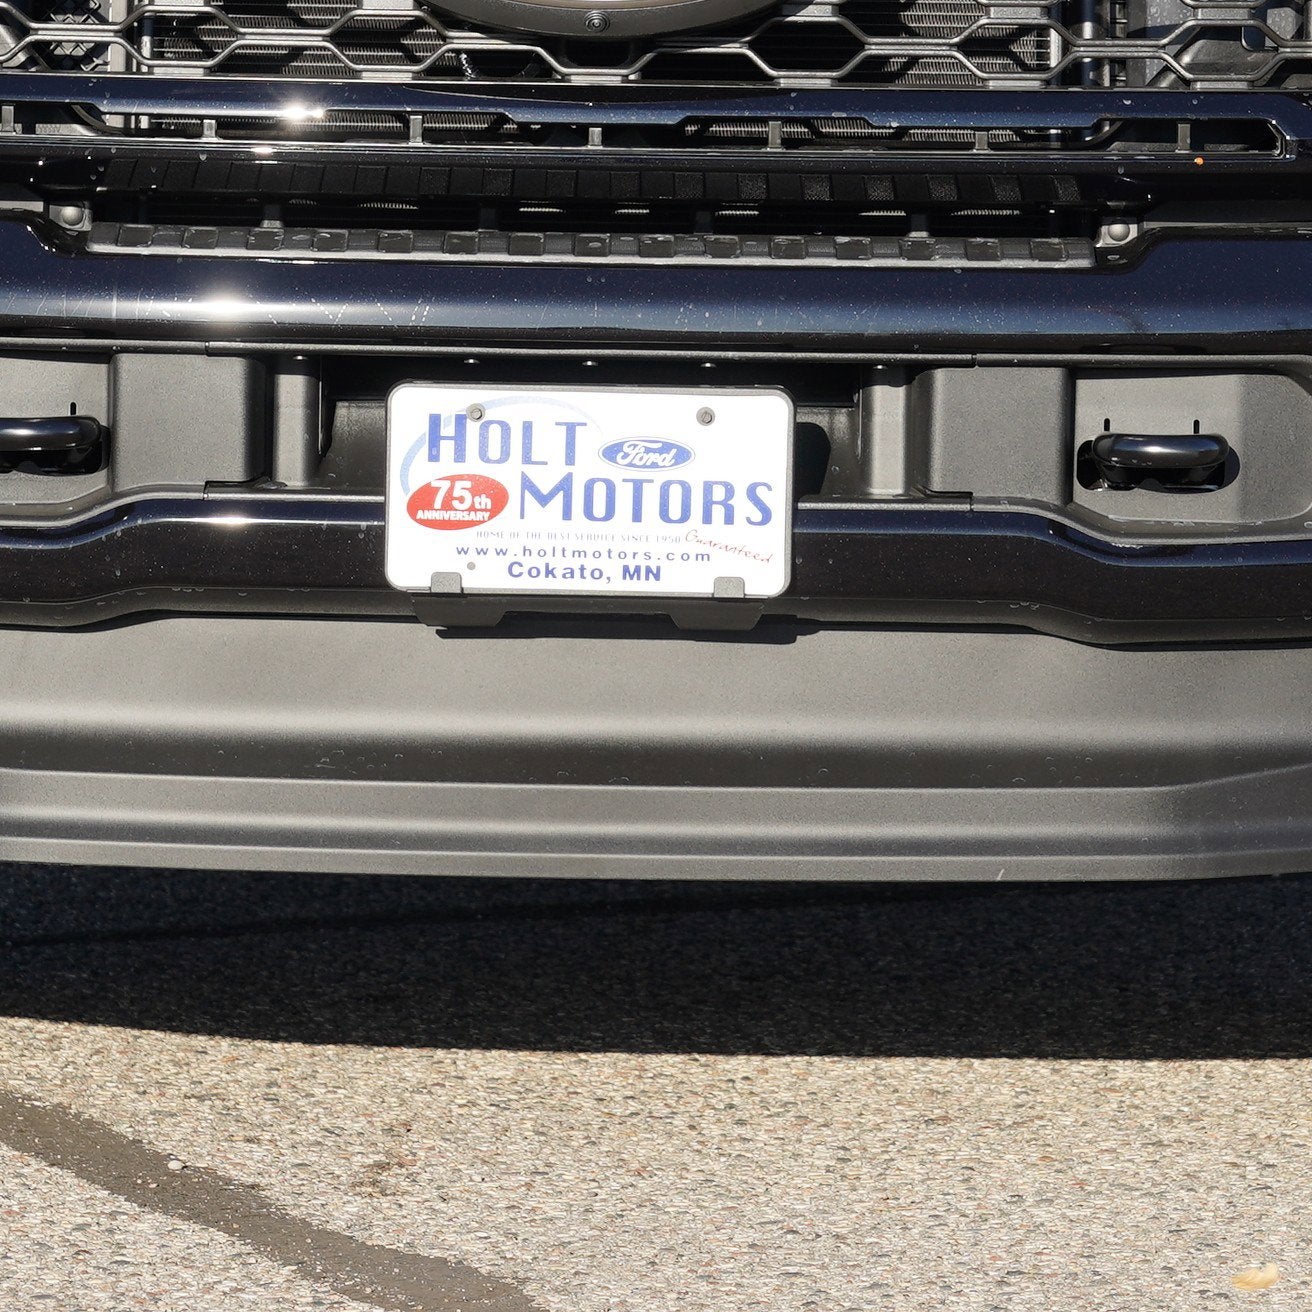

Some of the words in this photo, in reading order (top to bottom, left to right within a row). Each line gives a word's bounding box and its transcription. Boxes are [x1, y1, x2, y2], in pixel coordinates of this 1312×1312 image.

[427, 412, 588, 466] HOLT
[616, 439, 677, 469] Ford
[430, 478, 492, 511] 75th
[519, 470, 773, 527] MOTORS
[415, 509, 491, 523] ANNIVERSARY
[476, 530, 505, 540] HOME
[575, 532, 616, 542] SERVICE
[621, 534, 650, 544] SINCE
[655, 534, 681, 545] 1950
[684, 528, 775, 565] Guaranteed
[455, 544, 712, 563] www.holtmotors.com
[506, 560, 612, 585] Cokato,
[621, 563, 662, 583] MN
